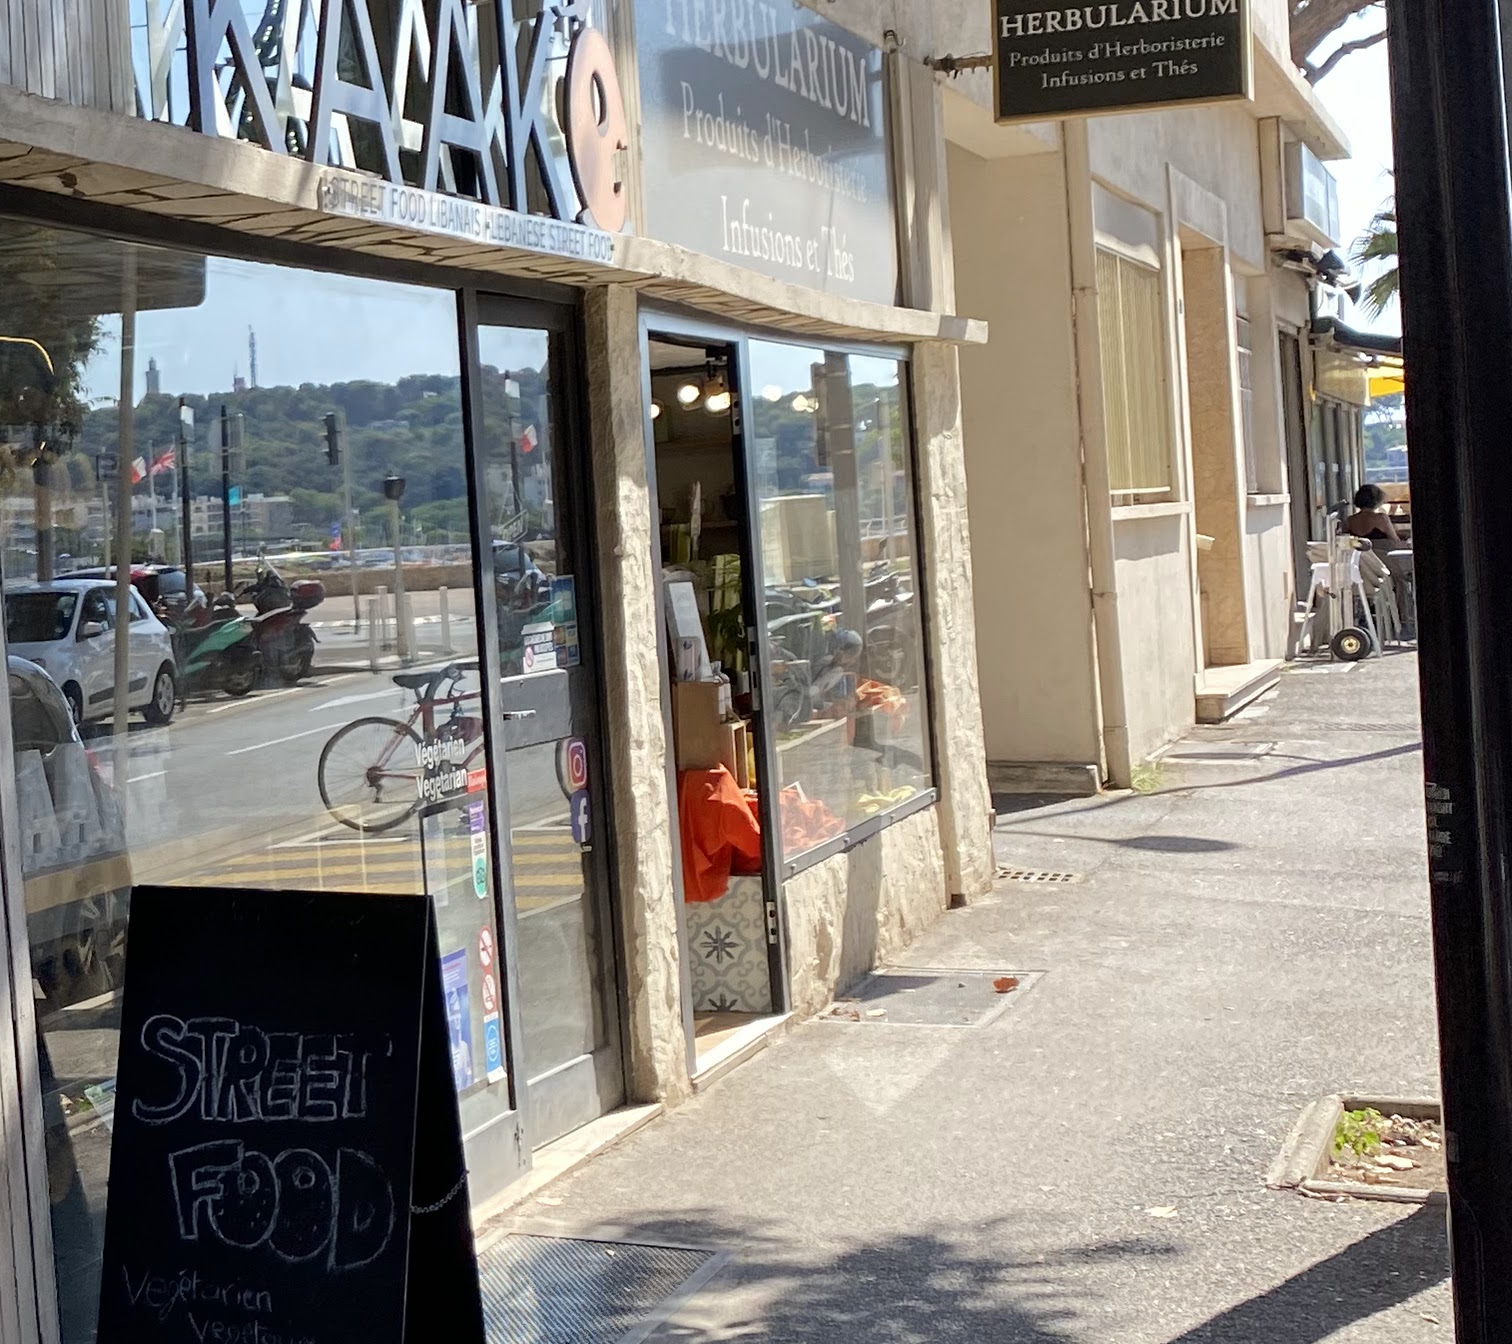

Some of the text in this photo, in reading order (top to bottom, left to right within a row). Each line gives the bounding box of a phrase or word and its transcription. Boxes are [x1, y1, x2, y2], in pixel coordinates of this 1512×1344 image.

[1010, 32, 1225, 67] Produits d'Herboristerie
[1041, 59, 1198, 89] Infusions et Thés
[681, 81, 759, 162] Produits
[330, 177, 613, 262] STREET FOOD LIBANAIS LEBANESE STREET FOOD
[721, 195, 855, 283] Infusions et Thés
[415, 736, 465, 770] Végétarien
[416, 767, 468, 802] Vegetarian
[131, 1014, 393, 1126] STREET
[168, 1139, 395, 1273] FOOD
